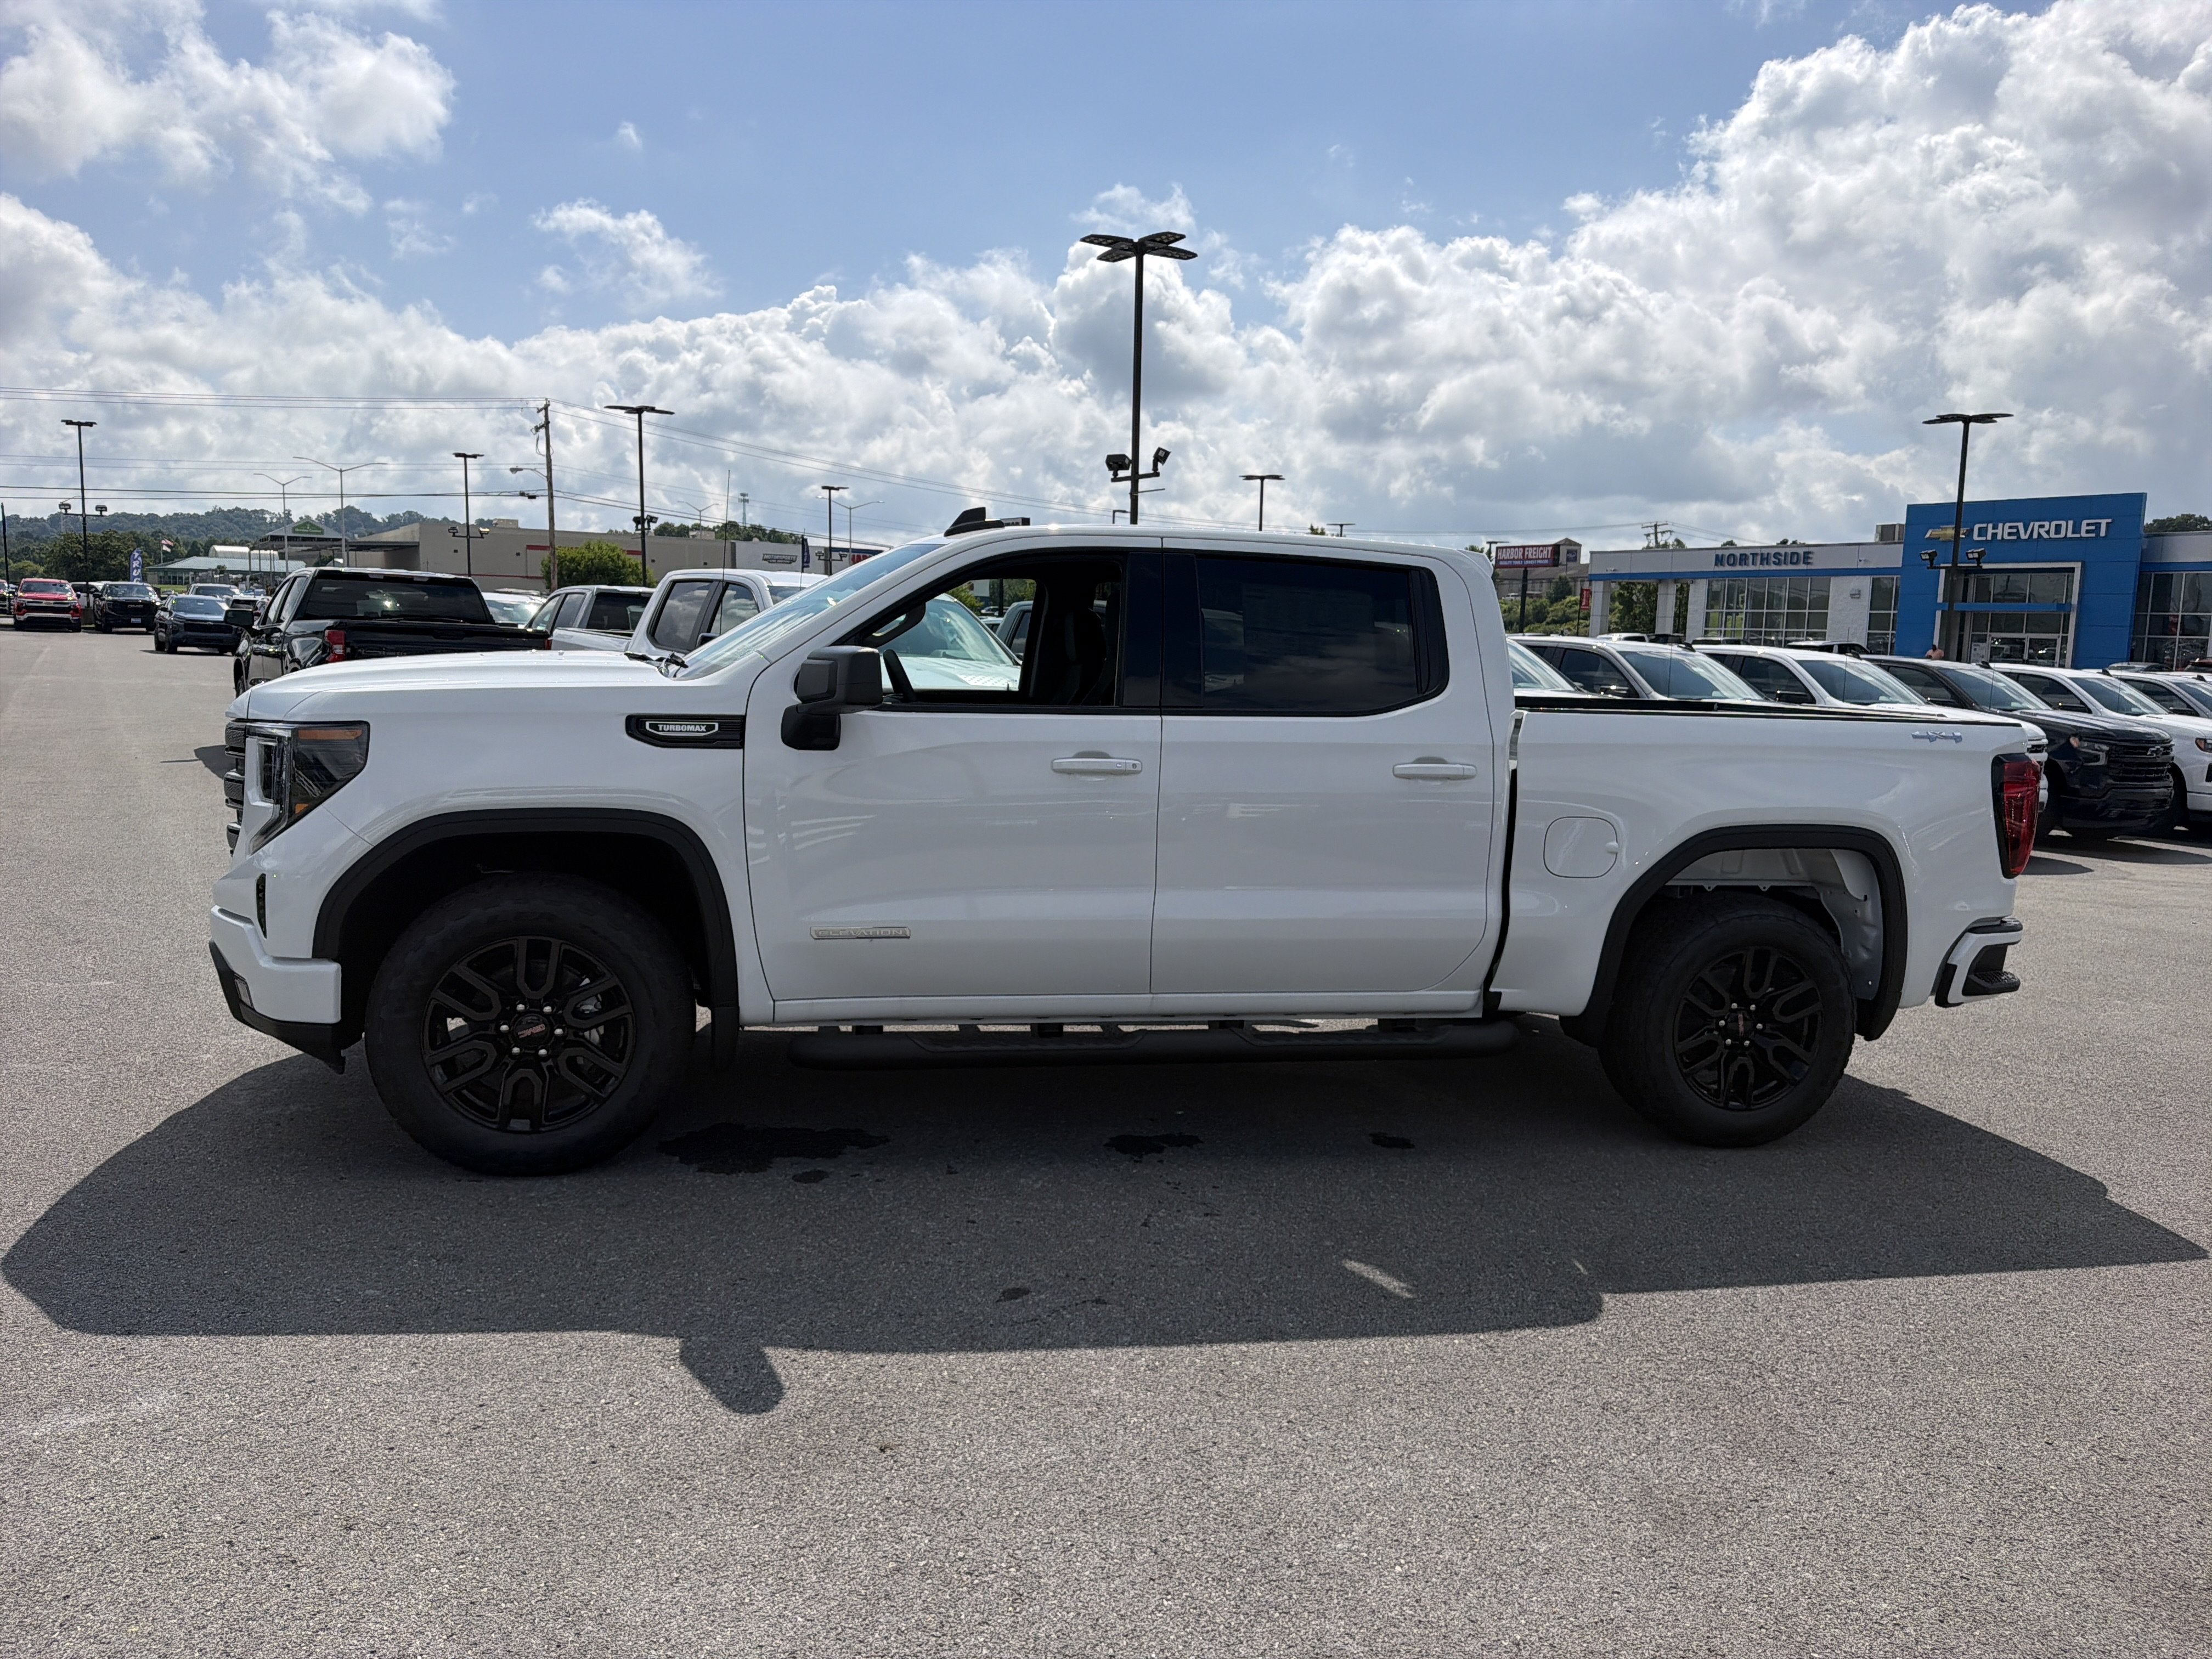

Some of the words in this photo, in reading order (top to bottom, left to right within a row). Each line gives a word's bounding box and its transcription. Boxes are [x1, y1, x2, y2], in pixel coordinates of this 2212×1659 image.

[1973, 518, 2112, 540] CHEVROLET
[1497, 548, 1523, 560] HARBOR
[1524, 546, 1553, 559] FREIGHT
[1714, 551, 1814, 567] NORTHSIDE
